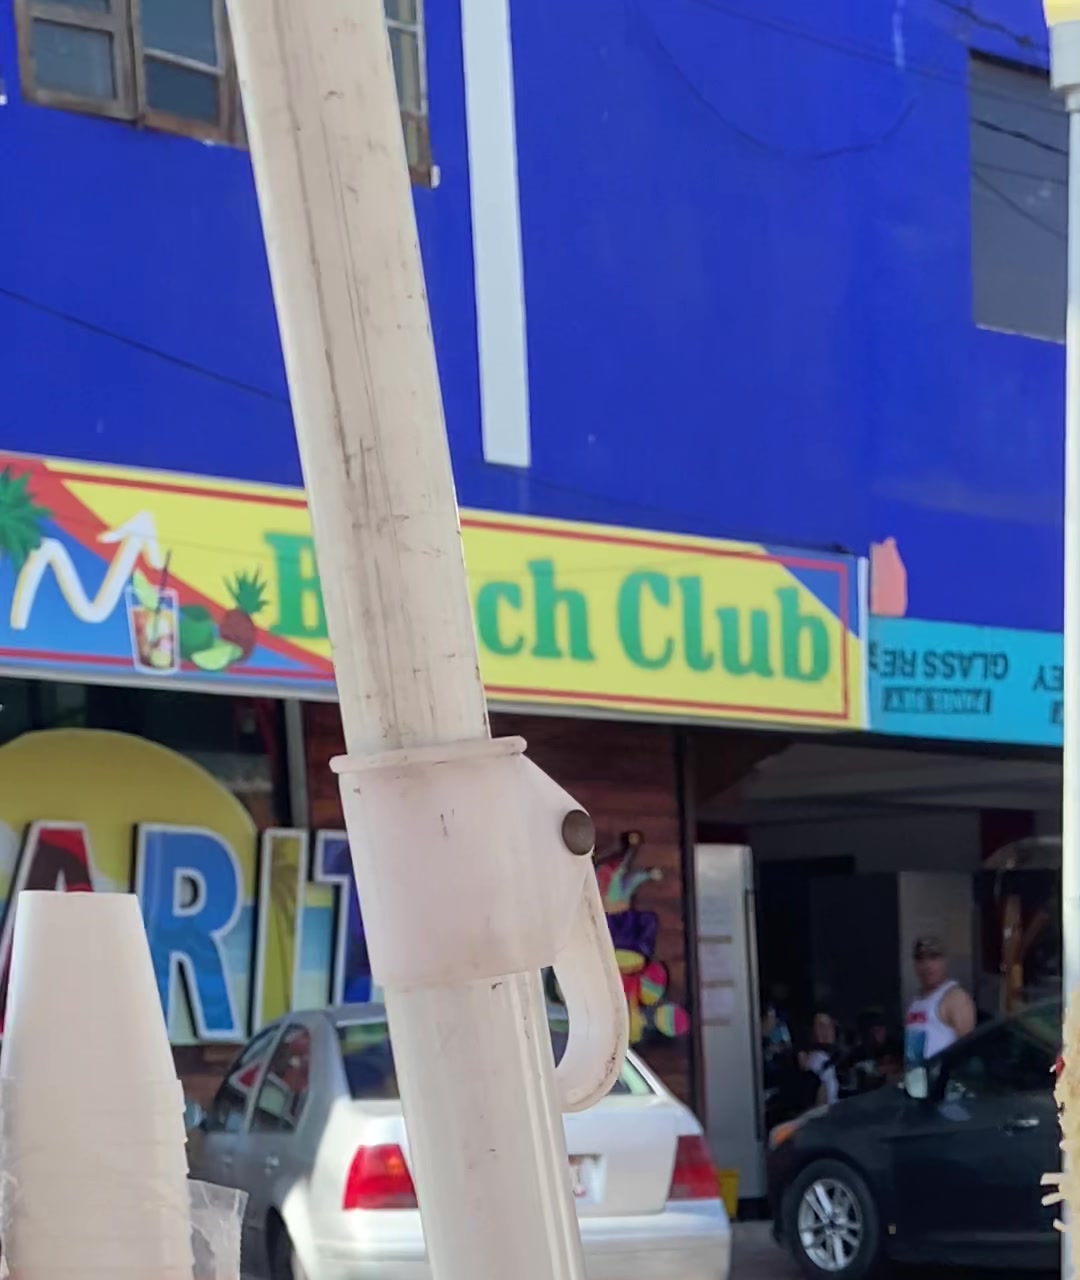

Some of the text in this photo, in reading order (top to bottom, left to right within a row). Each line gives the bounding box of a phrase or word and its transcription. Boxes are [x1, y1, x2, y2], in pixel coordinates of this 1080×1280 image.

[265, 532, 831, 683] Bch Club
[921, 649, 1008, 680] GLASS
